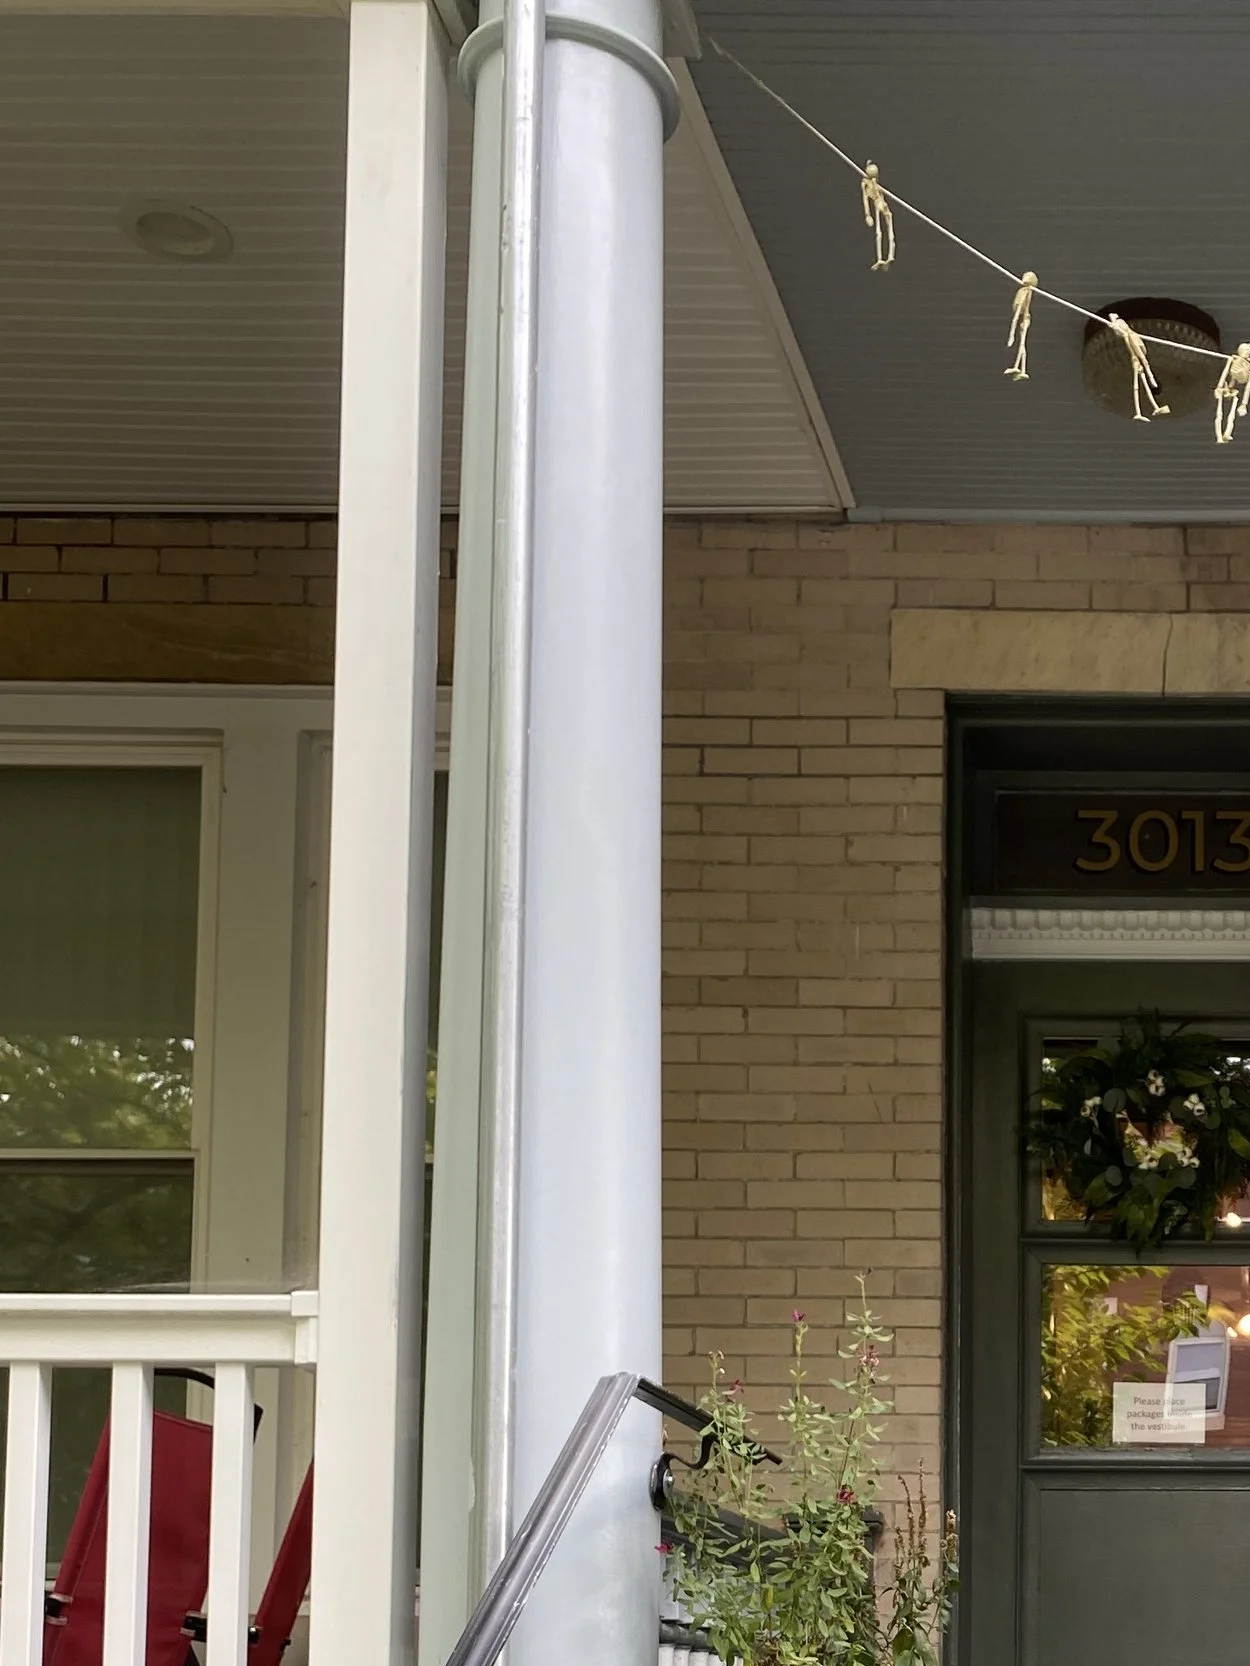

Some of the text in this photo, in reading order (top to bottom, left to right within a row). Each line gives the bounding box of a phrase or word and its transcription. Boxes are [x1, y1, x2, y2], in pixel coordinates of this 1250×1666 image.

[1133, 1396, 1186, 1407] Please ace
[1131, 1422, 1145, 1431] the
